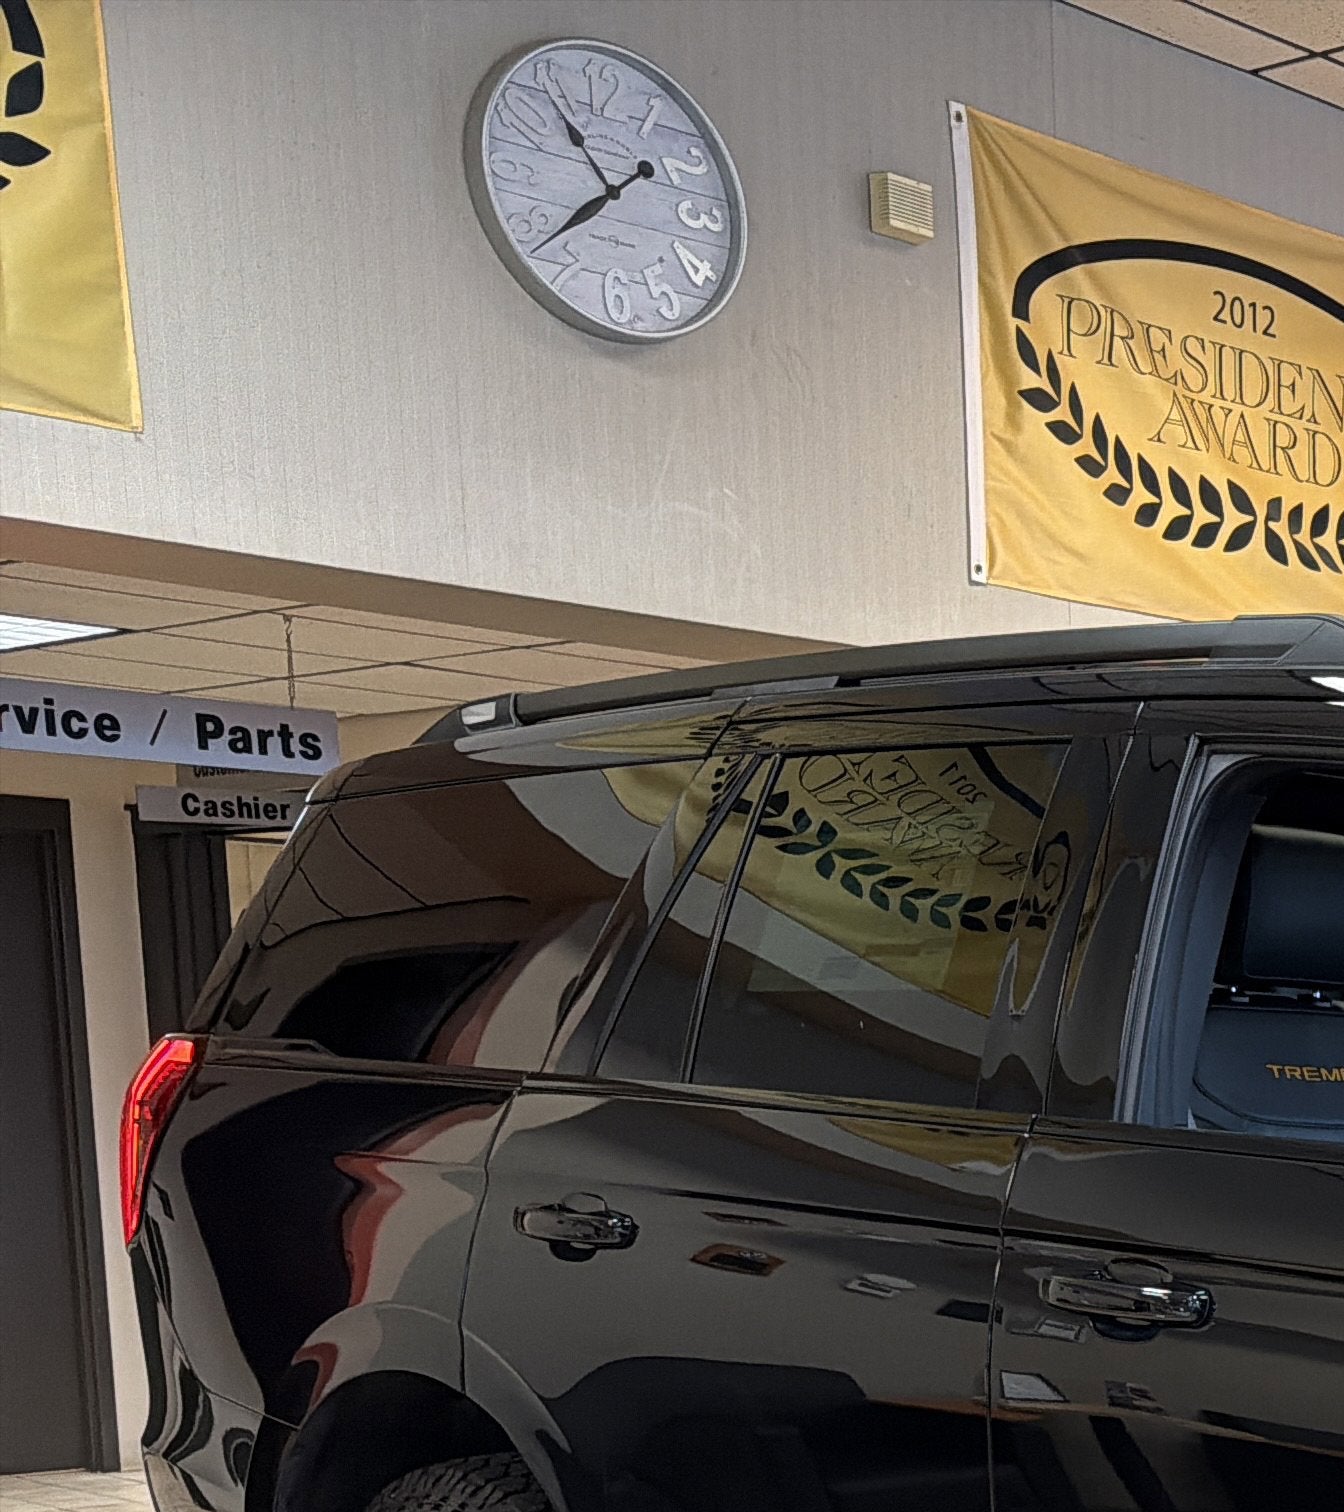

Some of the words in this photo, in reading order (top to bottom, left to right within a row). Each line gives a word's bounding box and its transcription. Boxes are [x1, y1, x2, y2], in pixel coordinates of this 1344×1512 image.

[583, 58, 628, 124] 12
[636, 95, 661, 140] 1
[661, 146, 708, 185] 2
[678, 199, 723, 232] 3
[672, 240, 717, 286] 4
[603, 268, 631, 323] 6
[643, 263, 680, 320] 5
[1212, 290, 1278, 338] 2012
[1149, 390, 1342, 488] AWARD
[149, 709, 168, 746] /
[195, 712, 323, 761] Parts
[181, 792, 290, 820] Cashier
